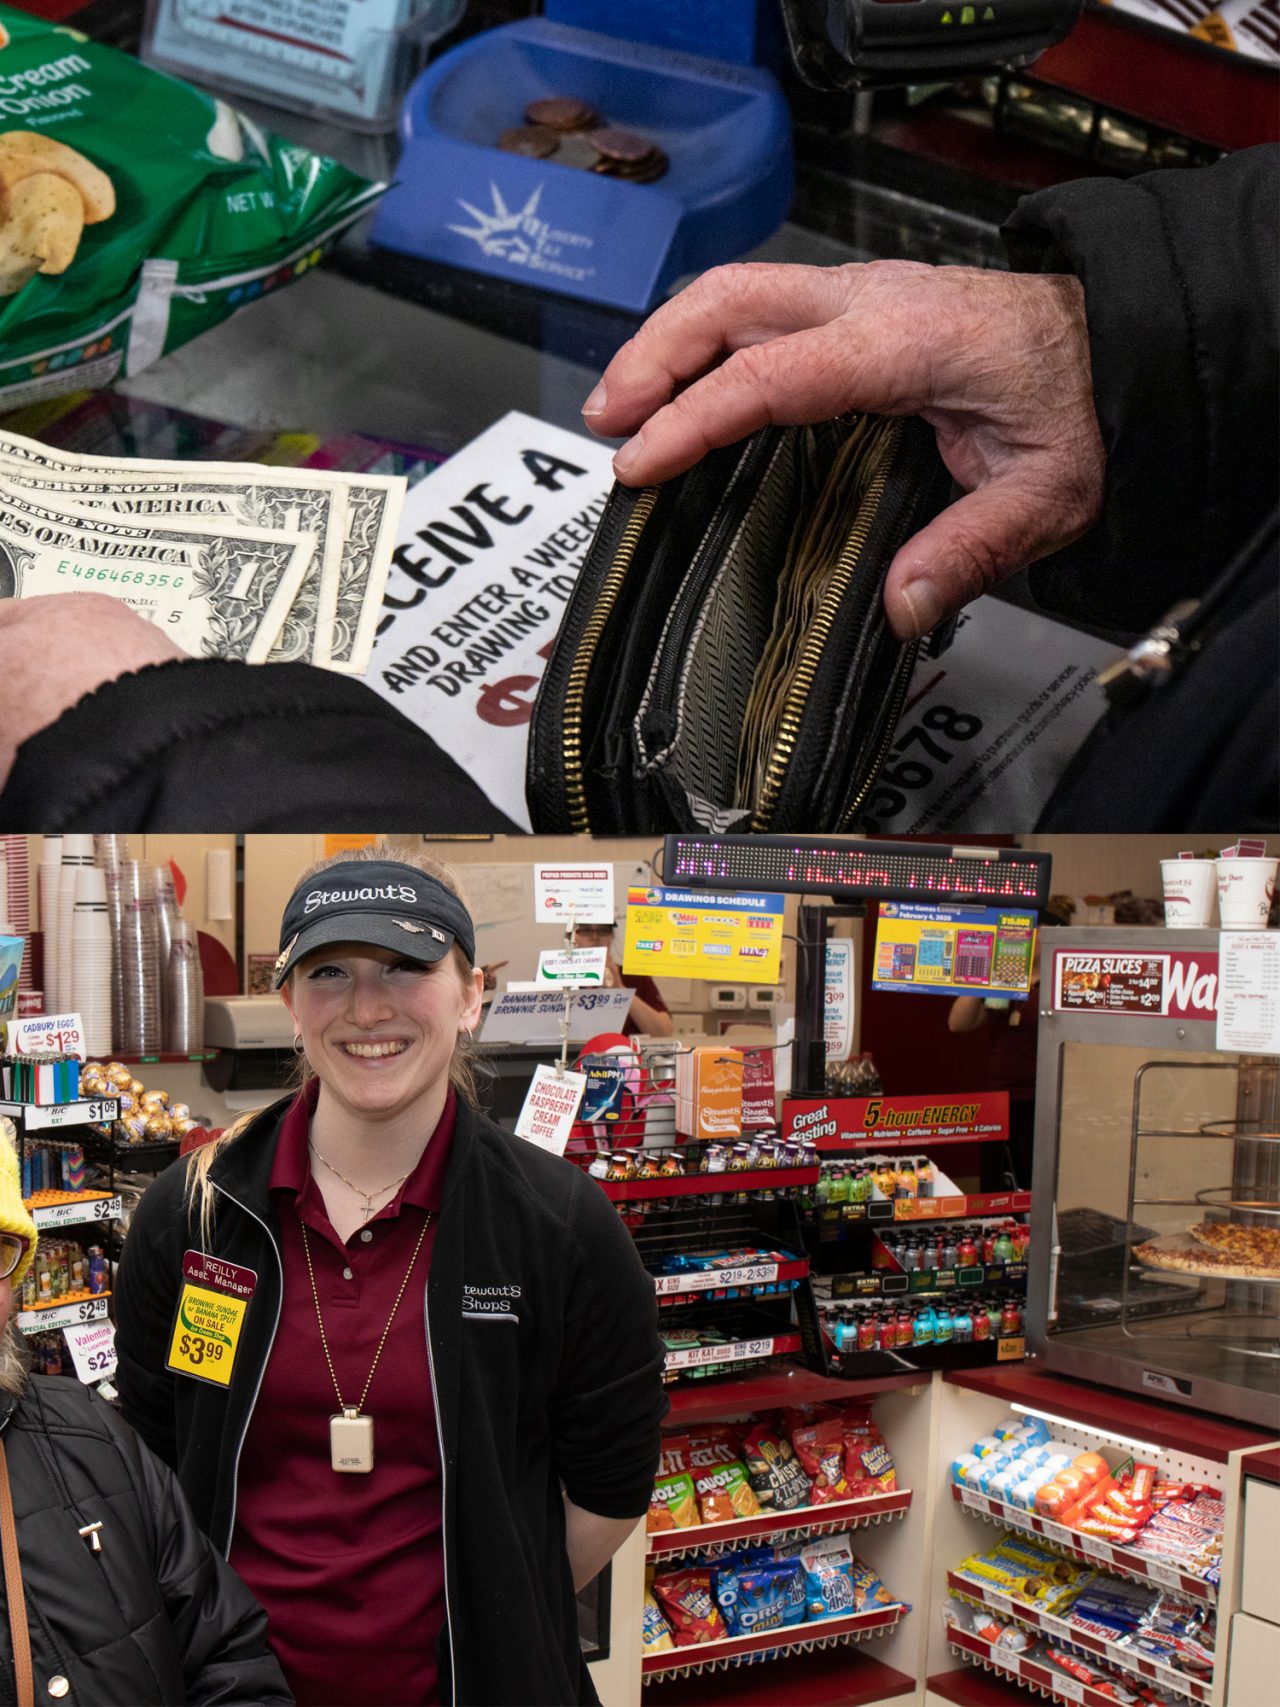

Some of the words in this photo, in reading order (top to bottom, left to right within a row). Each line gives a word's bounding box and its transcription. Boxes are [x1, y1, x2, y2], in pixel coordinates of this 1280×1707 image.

[226, 193, 258, 213] NET
[518, 448, 590, 492] A
[110, 500, 236, 515] AMERICA
[79, 519, 150, 537] NOTE
[35, 530, 75, 552] OF
[77, 537, 191, 566] AMERICA
[167, 610, 183, 624] 5
[382, 644, 442, 695] AND
[431, 583, 519, 649] ENTER
[511, 566, 543, 600] A
[425, 599, 552, 698] DRAWING
[538, 575, 576, 601] TO
[304, 884, 418, 914] Stewart's
[665, 893, 716, 904] DRAWINGS
[717, 896, 766, 907] SCHEDULE
[899, 912, 927, 921] February
[1065, 958, 1100, 973] PIZZA
[1102, 959, 1143, 974] SLICES
[502, 994, 538, 1004] BANANA
[494, 1004, 535, 1015] BROWNIE
[23, 1022, 54, 1033] CADBURY
[57, 1019, 75, 1028] EGGS
[589, 1070, 608, 1078] Advil
[535, 1081, 578, 1102] CHOCOLATE
[529, 1095, 574, 1115] RASPBERRY
[533, 1110, 561, 1126] CREAM
[793, 1104, 828, 1130] Great
[864, 1101, 922, 1128] 5-hour
[923, 1104, 980, 1124] ENERGY
[530, 1124, 555, 1138] COFFEE
[791, 1120, 837, 1145] Tasting
[840, 1131, 867, 1140] Vitamins
[873, 1129, 901, 1138] Nutrients
[907, 1127, 932, 1137] Caffeine
[938, 1126, 954, 1135] Sugar
[955, 1126, 968, 1134] Free
[979, 1123, 1002, 1132] Calories
[37, 1220, 61, 1228] SPECIAL
[63, 1217, 87, 1225] EDITION
[205, 1261, 238, 1279] REILLY
[188, 1266, 210, 1280] Asst.
[214, 1275, 253, 1294] Manager
[188, 1296, 215, 1309] BROWNIE
[216, 1305, 239, 1317] SUNDAE
[194, 1316, 204, 1325] ON
[207, 1320, 225, 1332] SALE
[195, 1308, 218, 1320] BANANA
[219, 1314, 236, 1324] SPLIT
[21, 1324, 47, 1333] SPECIAL
[48, 1319, 72, 1328] EDITION
[199, 1327, 213, 1337] Cream
[75, 1326, 112, 1347] Valentine
[688, 1349, 699, 1359] KIT
[701, 1348, 715, 1356] KAT
[1070, 1615, 1120, 1640] RUNCH
